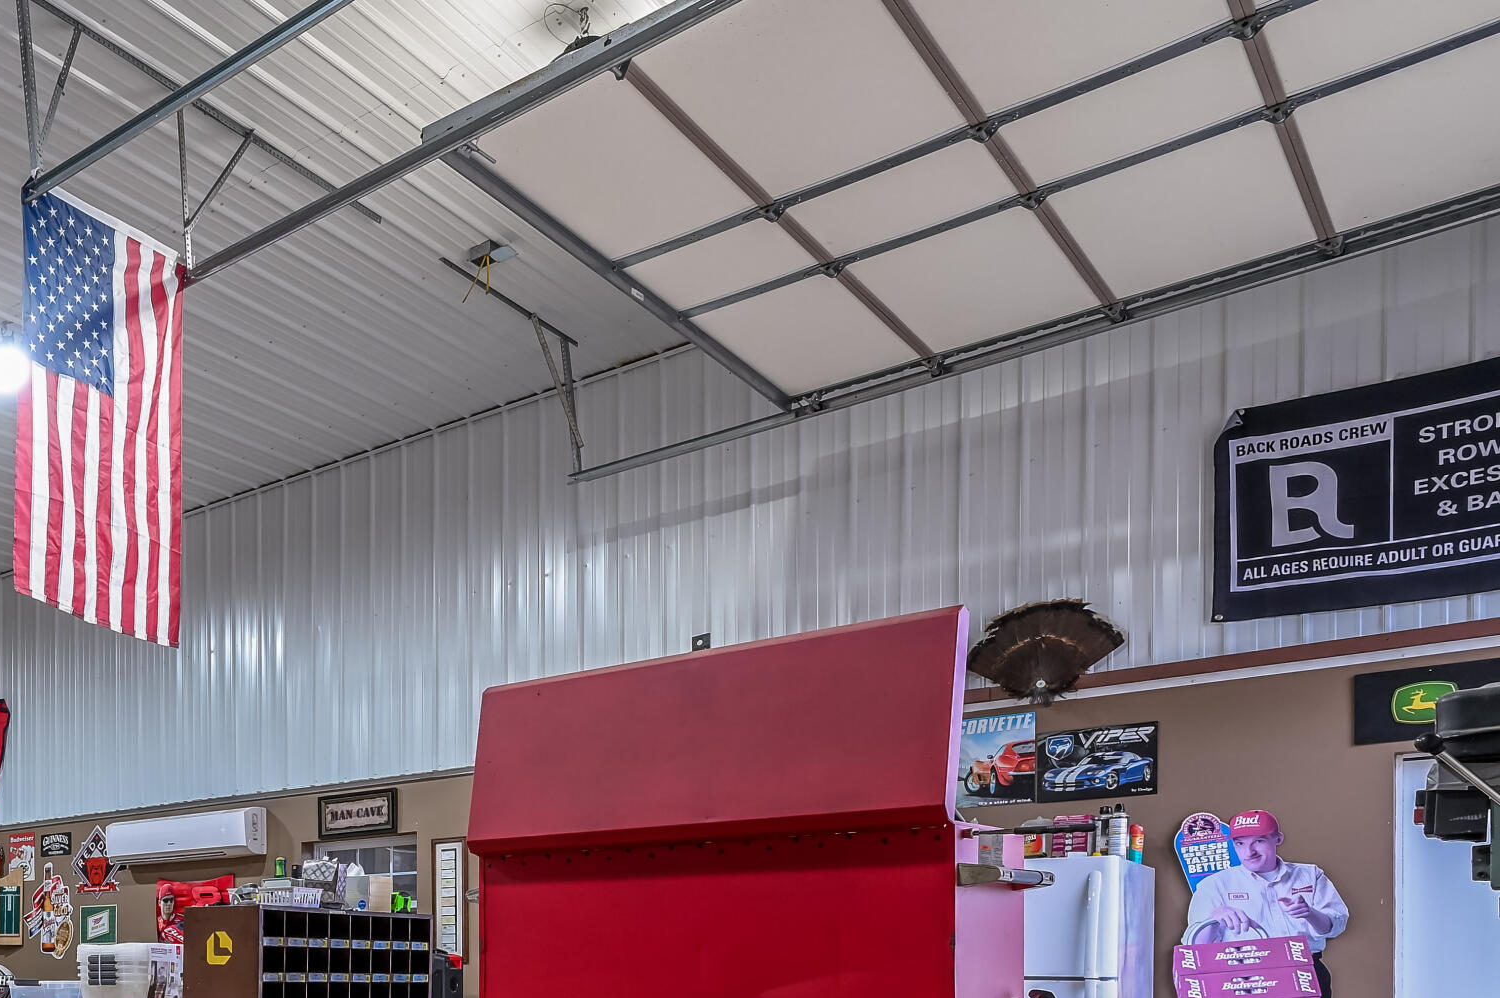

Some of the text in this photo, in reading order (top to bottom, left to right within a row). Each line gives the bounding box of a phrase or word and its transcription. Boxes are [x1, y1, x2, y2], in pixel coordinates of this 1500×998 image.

[1418, 412, 1500, 444] STRO
[1236, 420, 1387, 457] BACK ROADS CREW
[1269, 461, 1355, 548] R
[1436, 499, 1458, 517] &
[1243, 568, 1267, 581] ALL
[1271, 560, 1309, 577] AGES
[1312, 553, 1373, 572] REQUIRE
[1377, 546, 1428, 565] ADULT
[1432, 542, 1454, 557] OR
[330, 805, 384, 821] MAN CAVE
[1233, 814, 1260, 827] Bud
[10, 836, 34, 844] Budweiser
[42, 834, 69, 847] GUINNESS
[1180, 841, 1228, 854] FRESH
[1183, 848, 1229, 858] BEER
[1184, 853, 1230, 865] TASTES
[1188, 860, 1231, 874] BETTER
[1179, 948, 1197, 970] Bud
[1214, 950, 1271, 961] Budweiser
[1289, 940, 1308, 963] Bud
[1221, 980, 1279, 991] Budweiser
[1296, 969, 1317, 994] Bud
